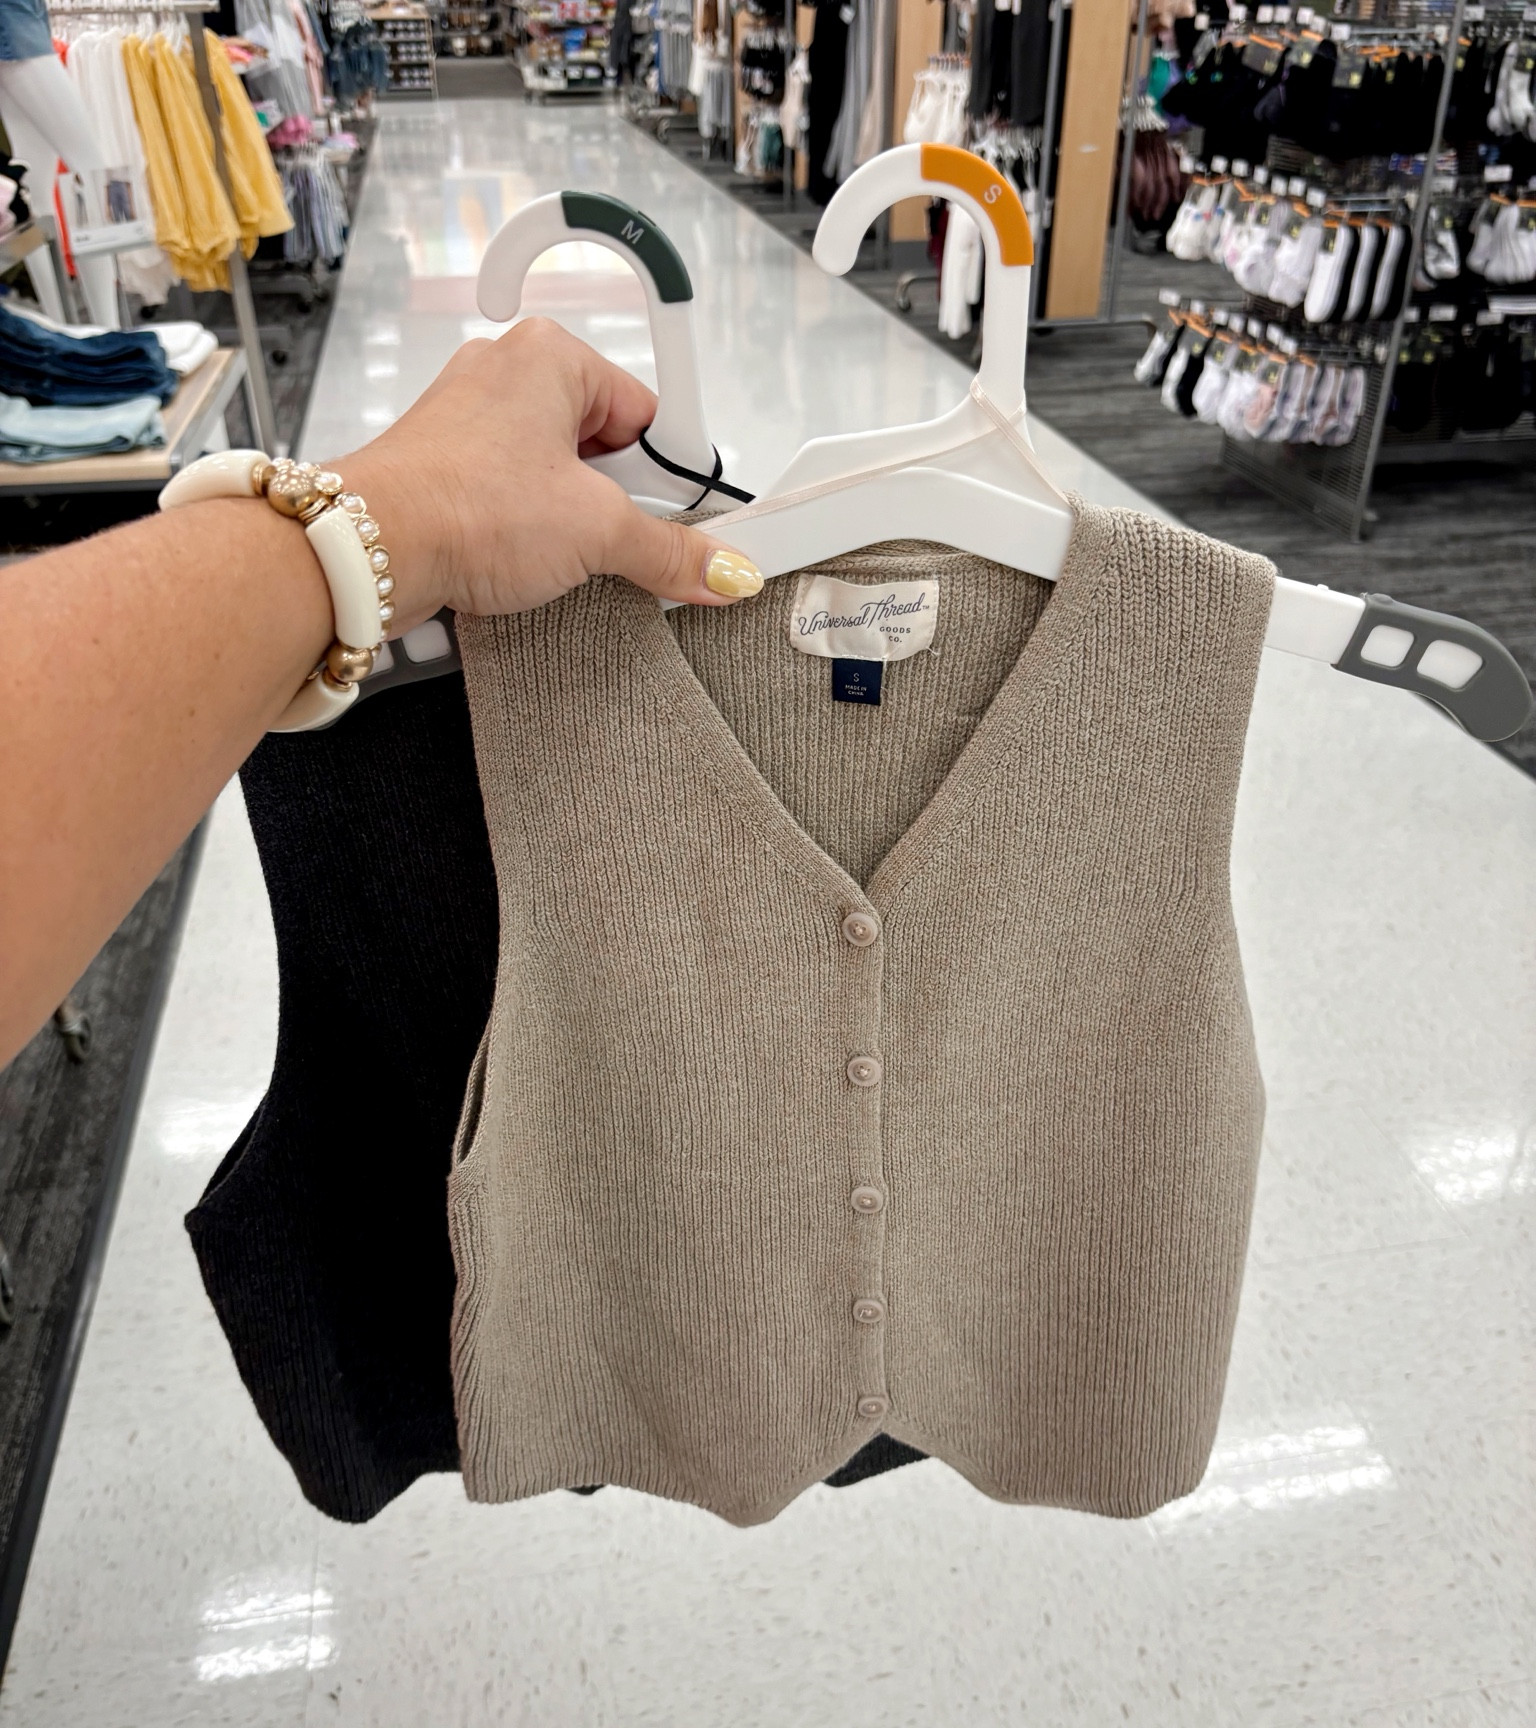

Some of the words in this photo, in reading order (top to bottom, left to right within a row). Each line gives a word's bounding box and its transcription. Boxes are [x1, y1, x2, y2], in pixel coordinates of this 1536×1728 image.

[984, 184, 1002, 204] S
[621, 219, 645, 245] M
[799, 606, 868, 636] Universal
[879, 626, 911, 634] GOODS
[888, 635, 903, 643] CO.
[853, 672, 860, 682] S
